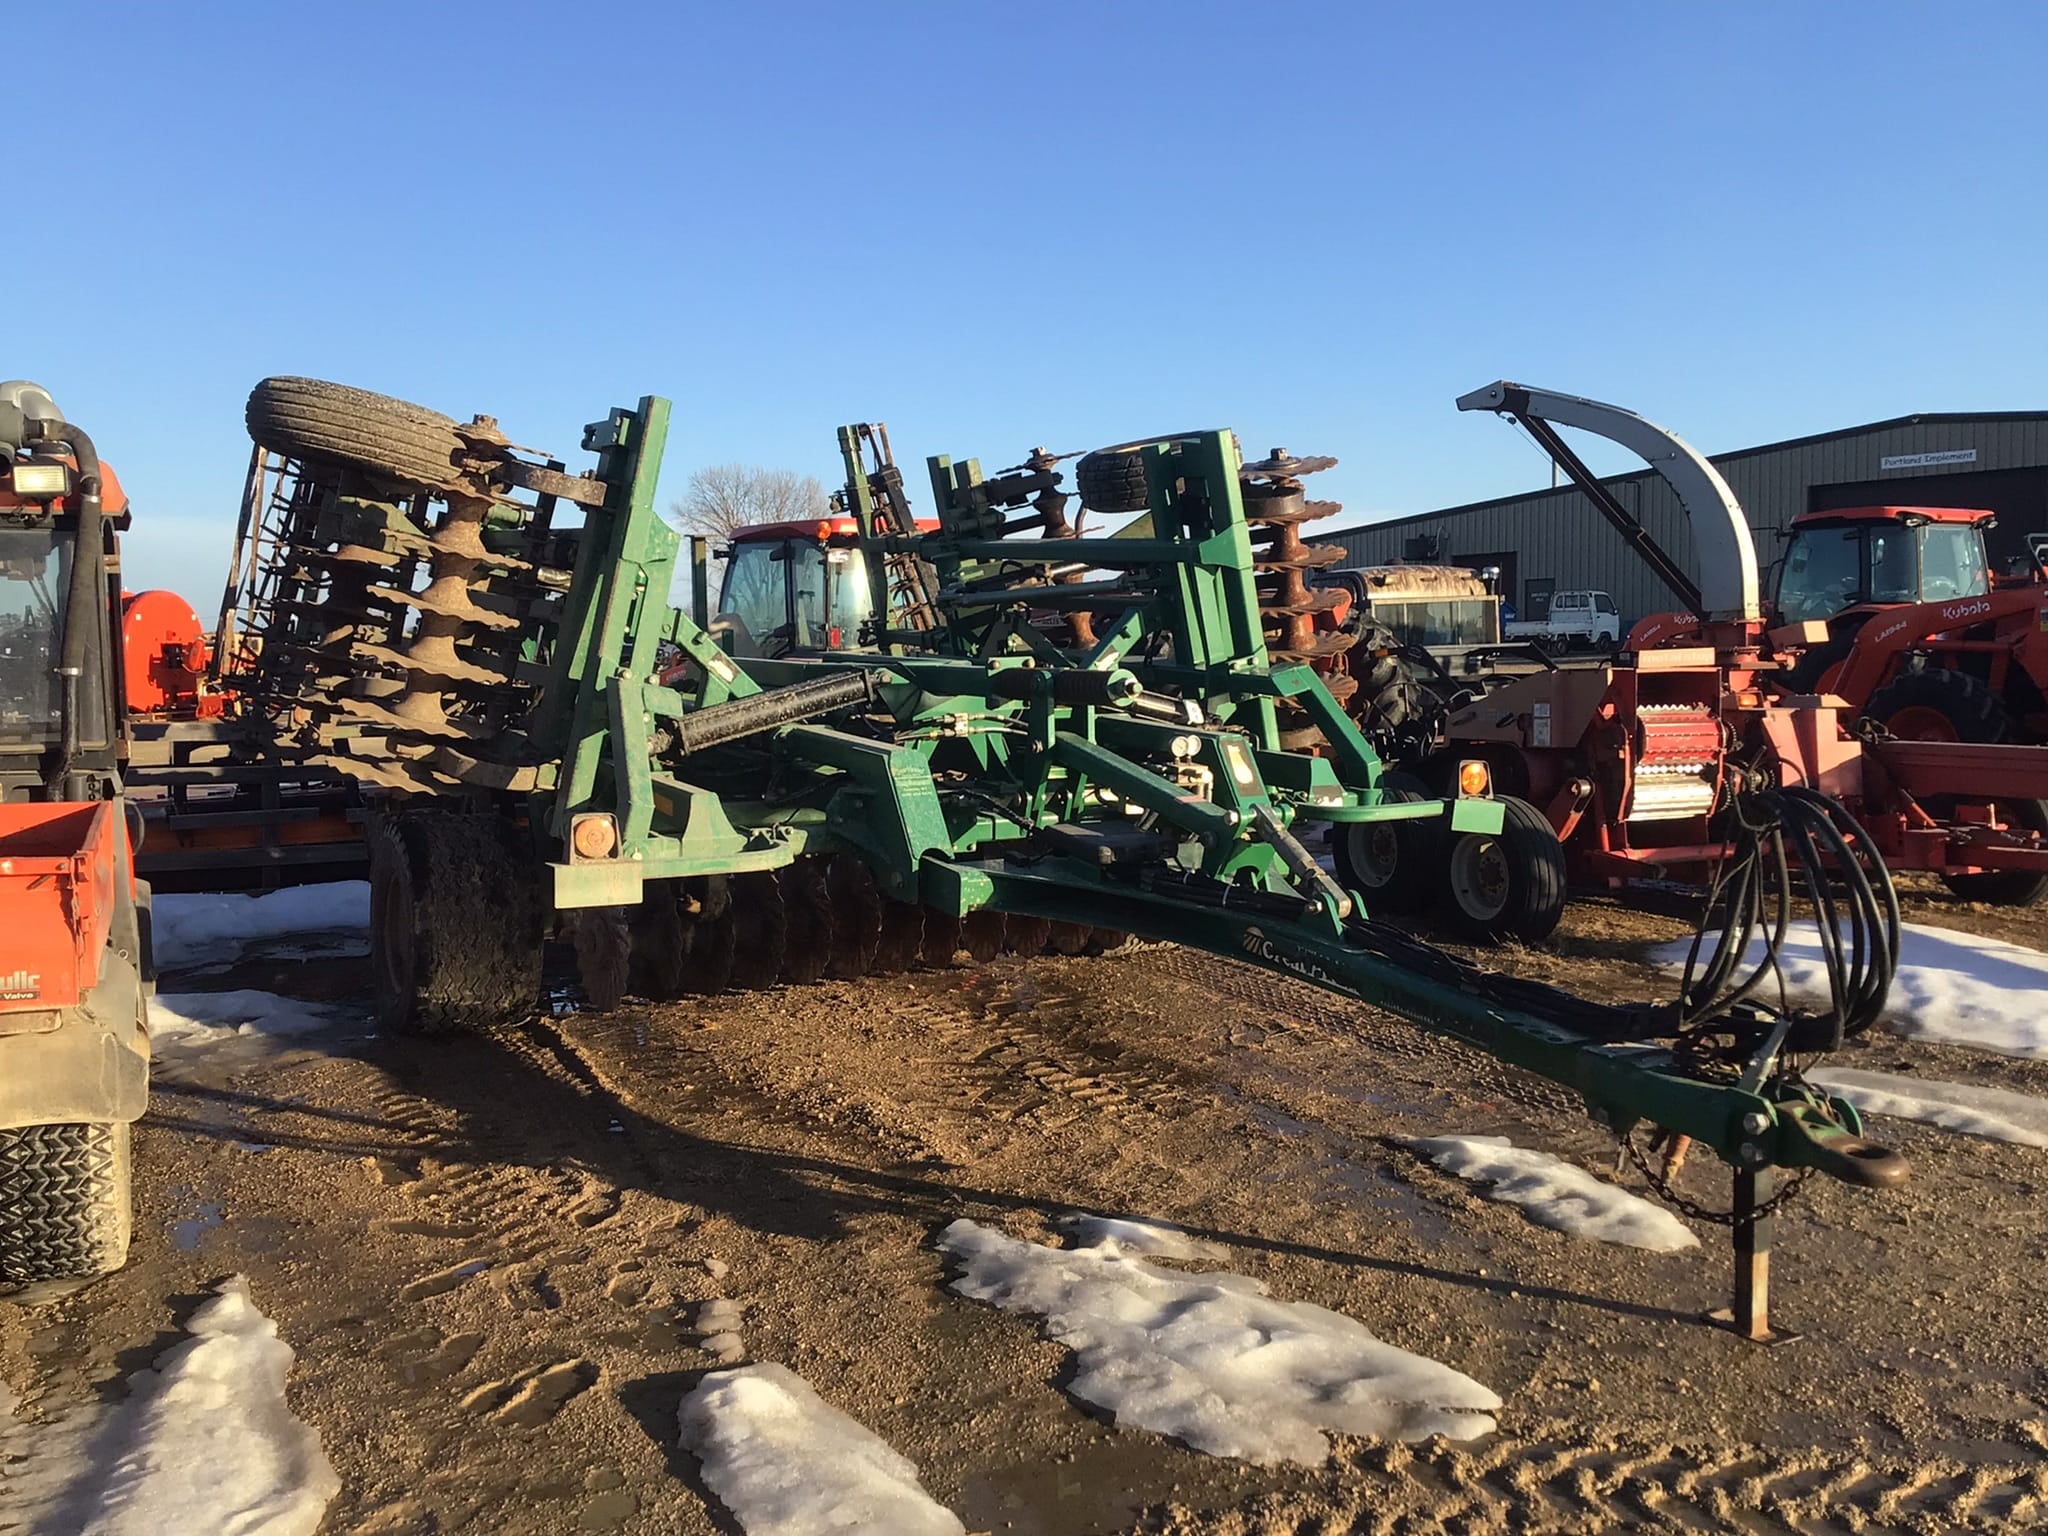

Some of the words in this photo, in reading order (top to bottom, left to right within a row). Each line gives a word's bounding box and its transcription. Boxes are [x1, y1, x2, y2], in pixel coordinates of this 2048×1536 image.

[1884, 456, 1922, 466] Portland
[1924, 452, 1973, 463] Implement
[1943, 601, 1991, 619] Kubota
